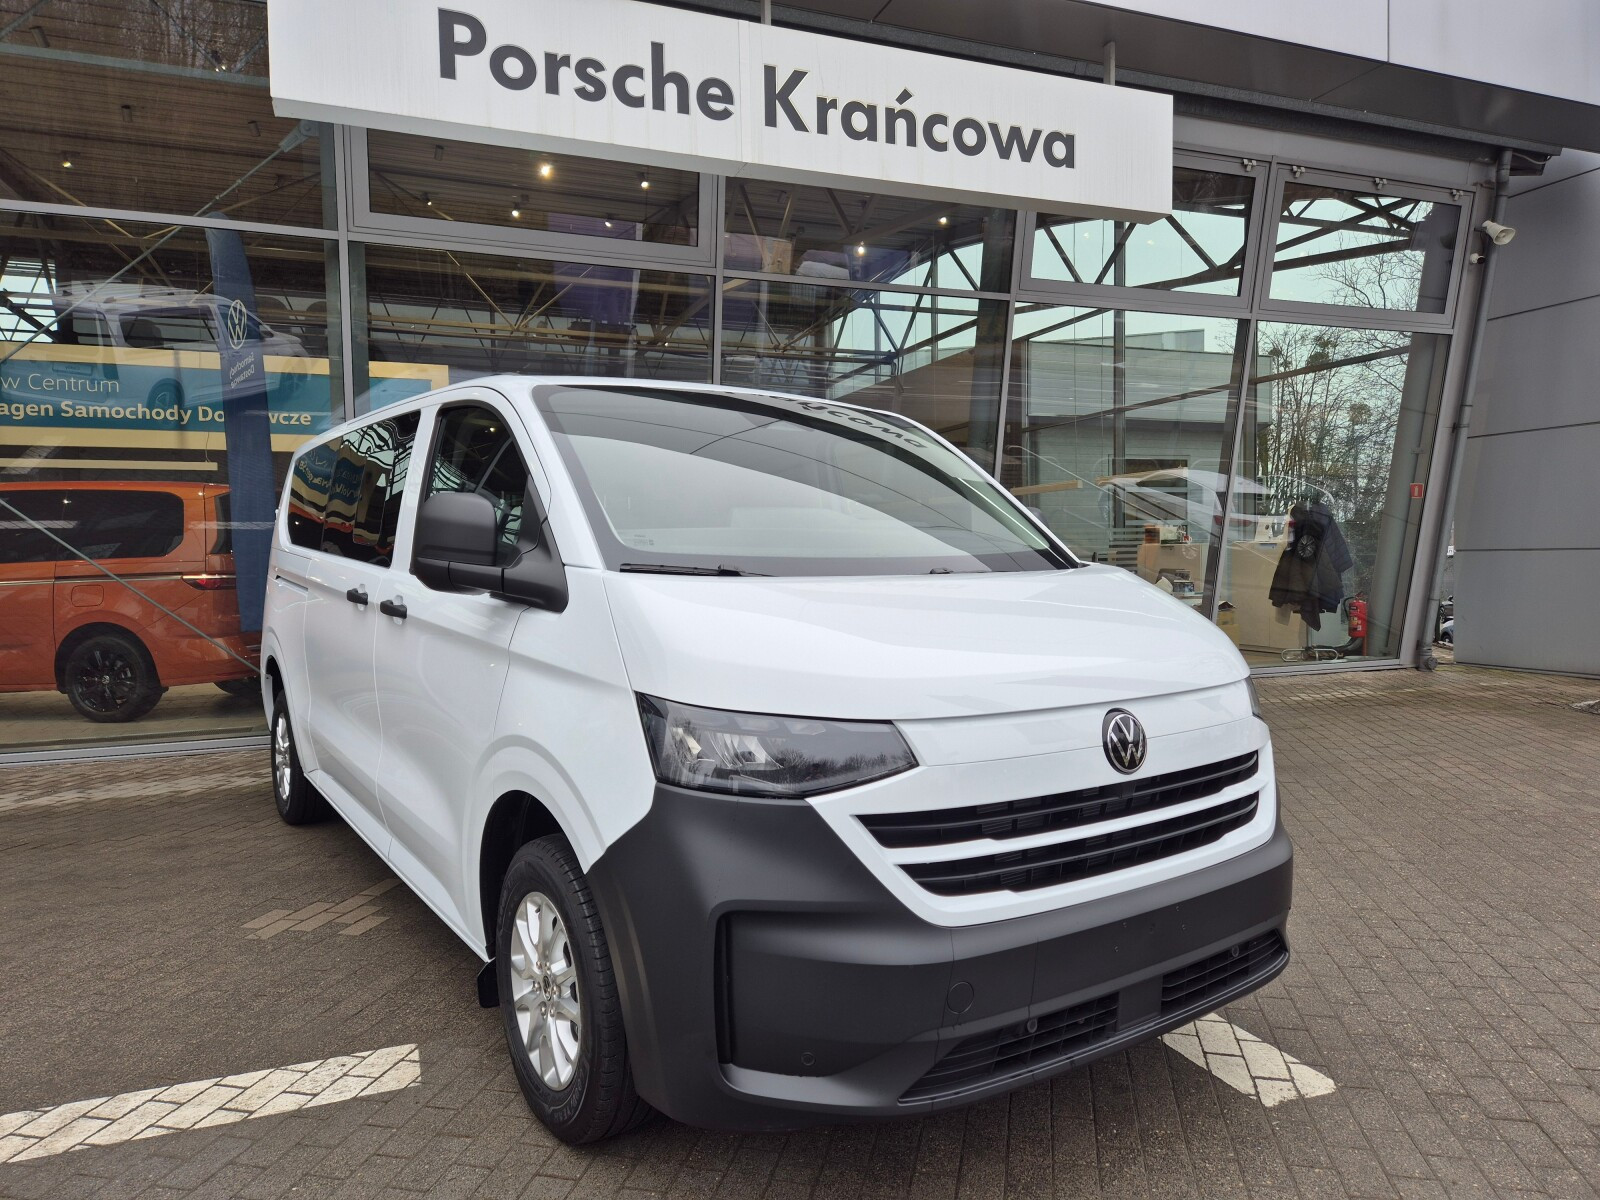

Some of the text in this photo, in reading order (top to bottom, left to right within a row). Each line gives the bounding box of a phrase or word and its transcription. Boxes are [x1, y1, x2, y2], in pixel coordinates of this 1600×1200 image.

[438, 6, 1076, 169] Porsche Krańcowa
[0, 373, 120, 393] w Centrum
[60, 401, 192, 425] Samochody
